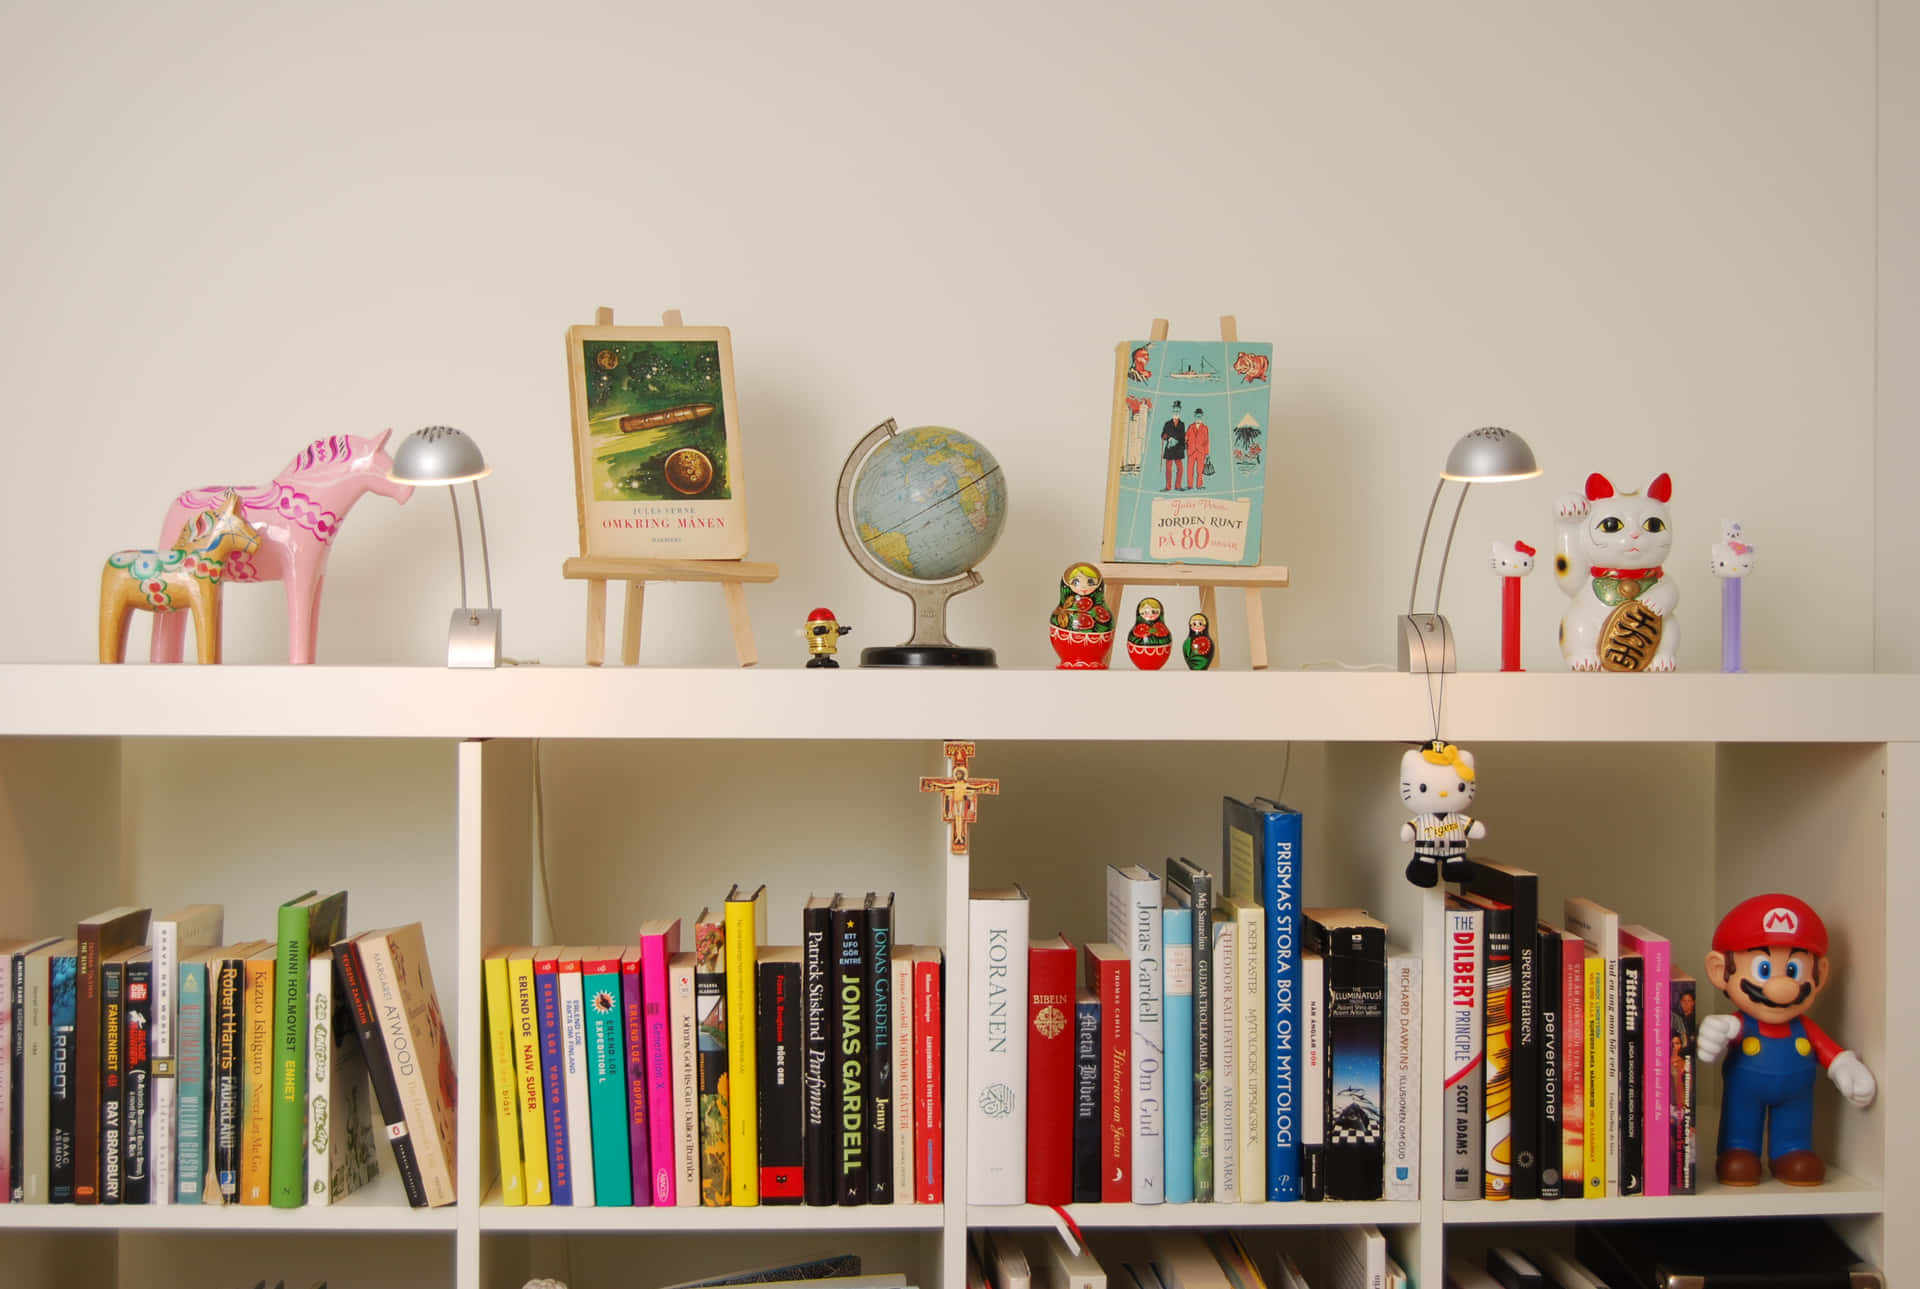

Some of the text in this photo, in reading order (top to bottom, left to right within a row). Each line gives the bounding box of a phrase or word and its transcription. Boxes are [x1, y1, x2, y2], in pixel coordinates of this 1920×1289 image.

[602, 515, 726, 529] OMKRING MÅNEN
[1158, 516, 1244, 529] JORDEN RUNT
[1158, 526, 1210, 550] PÅ 80
[1195, 892, 1209, 909] Maj
[1454, 916, 1473, 930] THE
[871, 928, 890, 1050] JONAS GARDELL
[988, 928, 1008, 1053] KORANEN
[1136, 901, 1160, 1023] Jonas Gardell
[1247, 921, 1257, 995] JOSEPH KASTER
[1453, 932, 1475, 1008] DILBERT
[222, 968, 238, 1069] Robert Harris
[250, 971, 268, 1075] Kazuo Ishiguro
[286, 940, 300, 1053] NINNI HOLMQVIST
[518, 975, 532, 1037] ERLEND LOE
[543, 983, 557, 1054] ERLEND LOE
[573, 999, 582, 1046] ERLEND LOE
[804, 931, 827, 1125] Patrick Süskind Parfymen
[1033, 995, 1067, 1004] BIBELN
[1221, 930, 1233, 1077] THEODOR KALLIFATIDES
[1276, 842, 1292, 1148] PRISMAS STORA BOK OM MYTOLOGI
[1399, 967, 1410, 1071] RICHARD DAWKINS
[1625, 968, 1639, 1031] Fittstim
[107, 1004, 119, 1071] FAHRENHEIT
[383, 1004, 415, 1077] ATWOOD
[596, 1020, 606, 1075] EXPEDITION
[606, 1020, 615, 1056] ERLEND
[629, 1004, 640, 1063] ERLEND LOE
[653, 1023, 664, 1078] Generation
[681, 1015, 693, 1049] Johnny
[900, 1033, 910, 1082] MORMOR
[1076, 1012, 1098, 1118] Metal Bibeln
[1198, 959, 1209, 1158] GUDAR TROLLKARLAR OCH VIDUNDER
[1454, 1010, 1472, 1062] PRINCIPLE
[284, 1061, 296, 1104] ENHET
[522, 1045, 537, 1113] NAIV. SUPER.
[655, 1081, 665, 1089] X
[841, 974, 862, 1175] JONAS GARDELL
[1112, 1046, 1126, 1103] Historien
[1138, 1058, 1160, 1138] Om Gud
[1244, 1008, 1258, 1146] MYTOLOGISK UPPSLAGSBOK
[1456, 1084, 1469, 1115] SCOTT
[1543, 1012, 1556, 1122] perversioner
[549, 1065, 567, 1187] VOLVO LASTVAGNAR
[632, 1080, 643, 1124] DOPPLER
[873, 1096, 890, 1131] Jenny
[1113, 1105, 1122, 1123] om
[1398, 1074, 1407, 1160] ILLUSIONEN OM GUD
[54, 1128, 63, 1169] ASIMOV
[62, 1132, 71, 1161] ISAAC
[107, 1101, 119, 1198] RAY BRADBURY
[181, 1096, 200, 1178] WILLIAM GIBSON
[1223, 1085, 1236, 1191] AFRODITES TÅRAR
[1456, 1117, 1468, 1155] ADAMS
